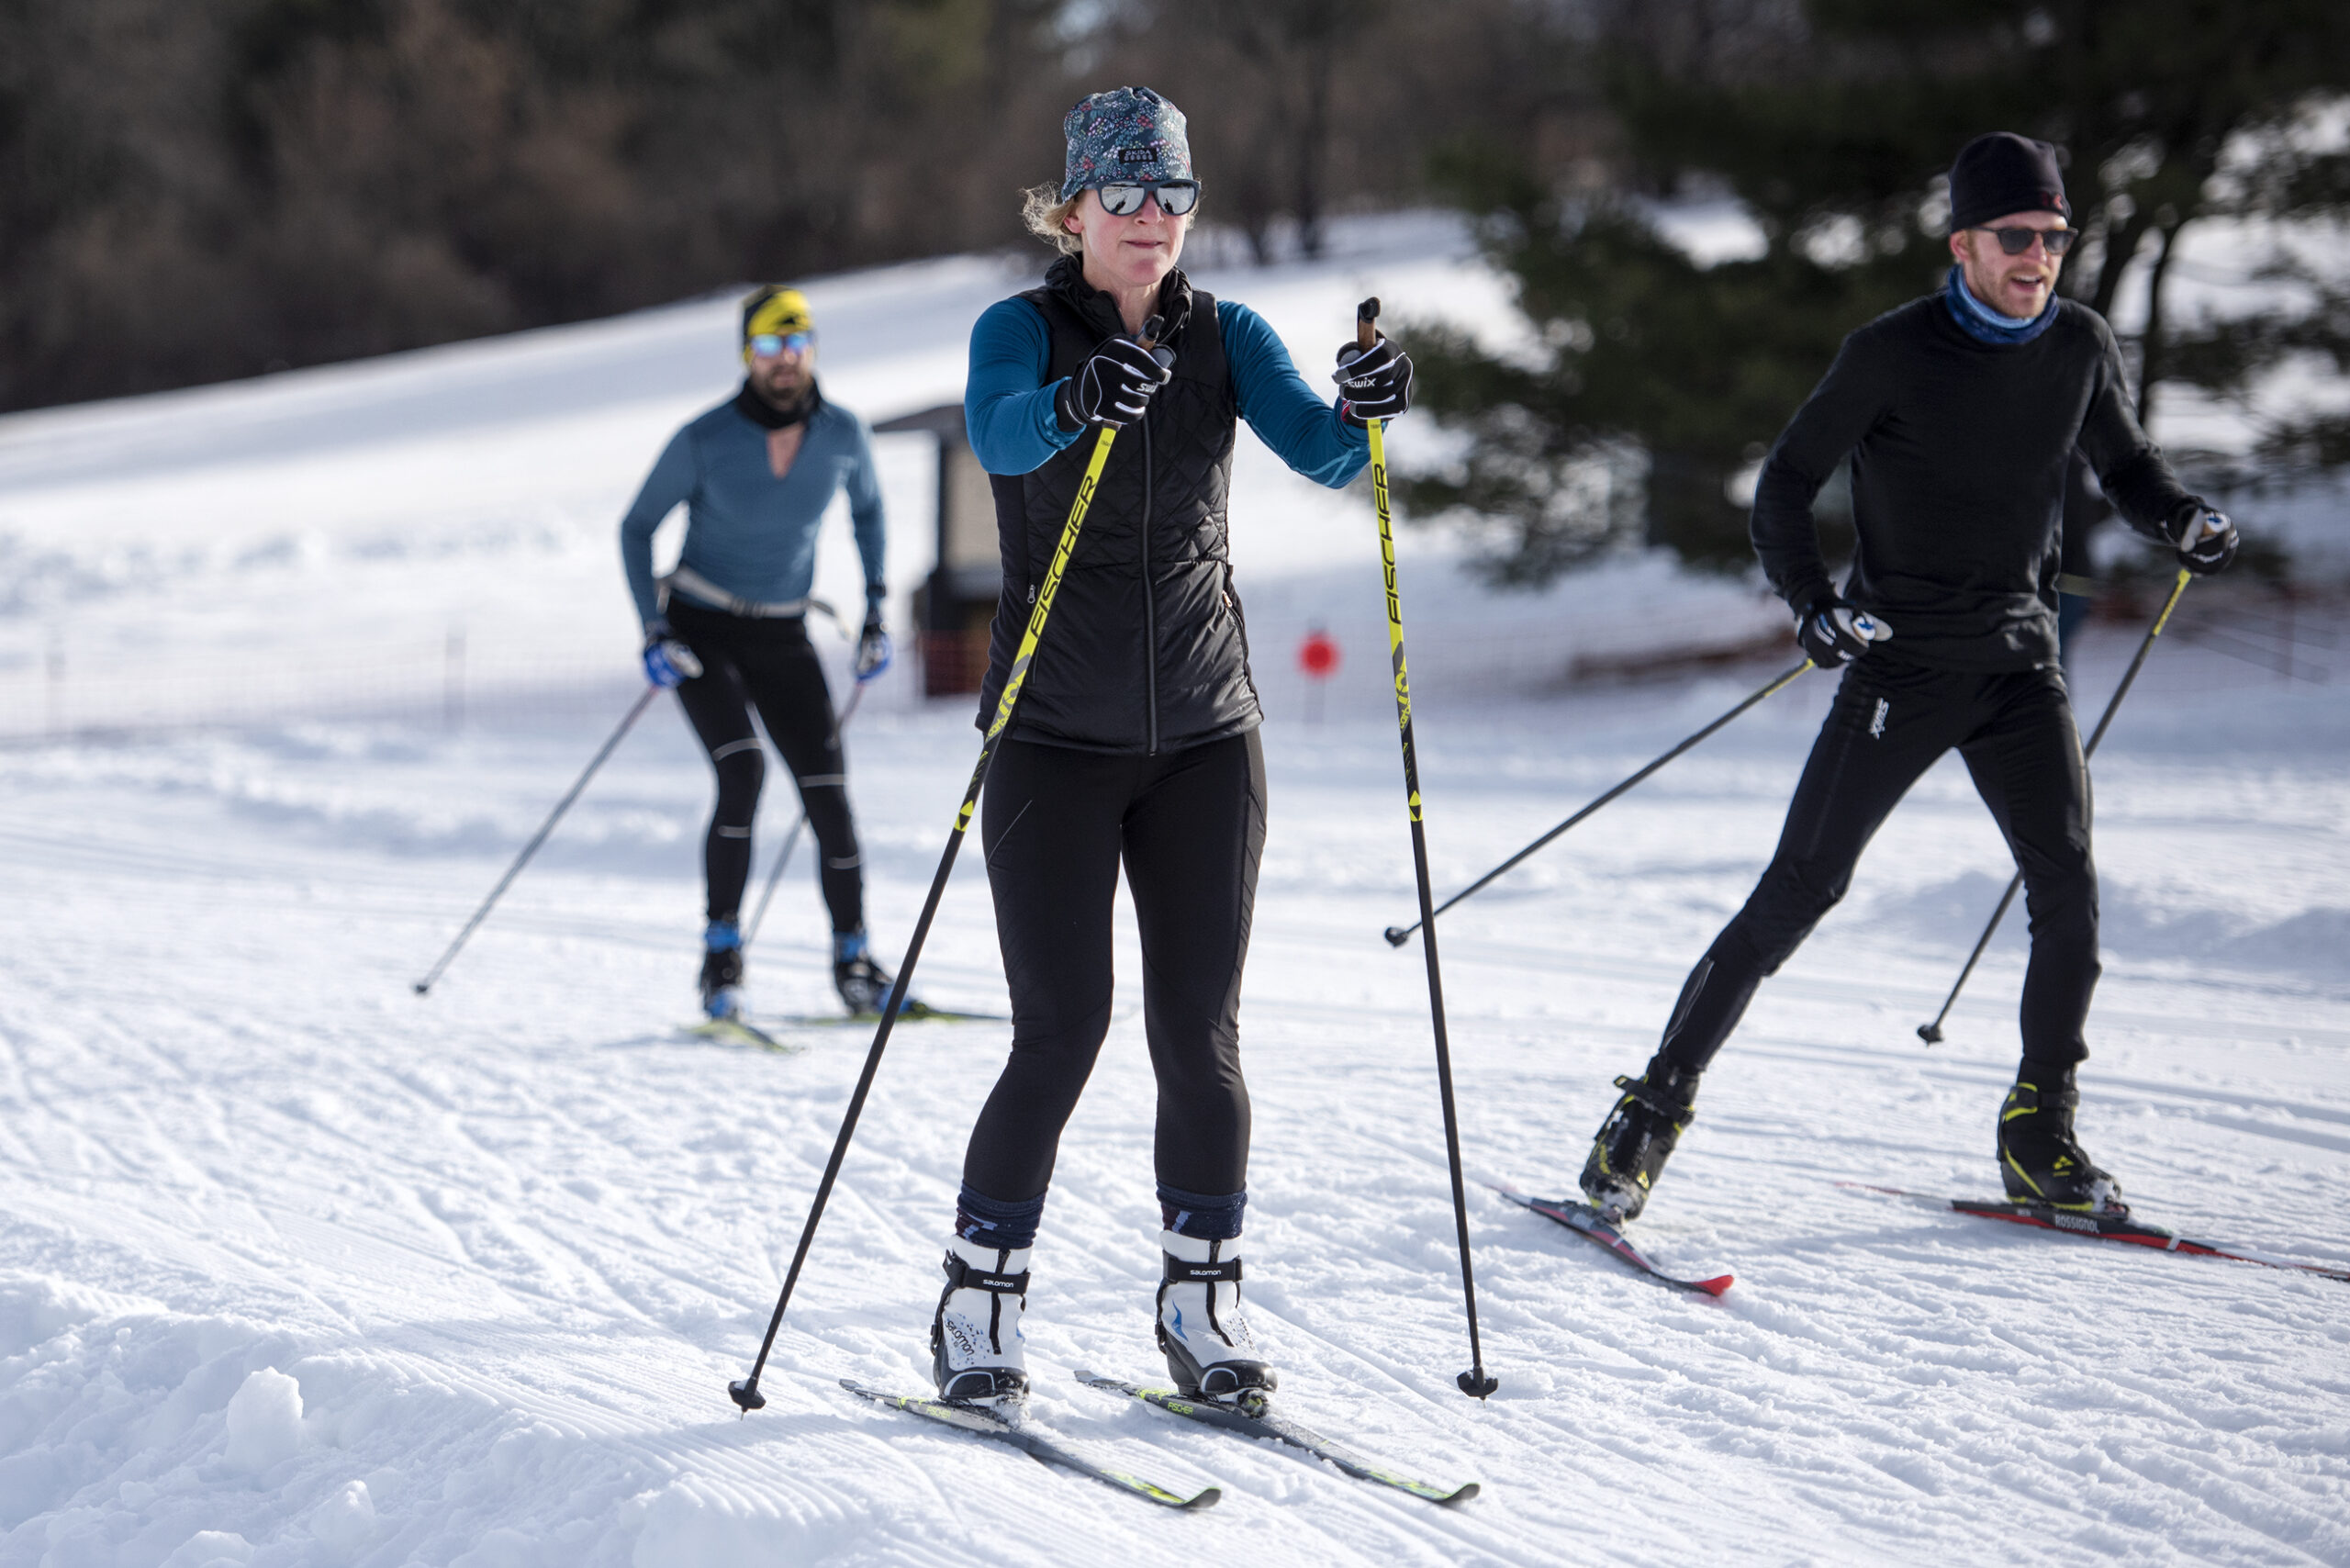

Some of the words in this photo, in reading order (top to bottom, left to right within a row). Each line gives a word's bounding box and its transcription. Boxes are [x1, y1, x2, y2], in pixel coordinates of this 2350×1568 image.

[1030, 474, 1097, 640] FISCHER
[1374, 463, 1403, 625] FISCHER
[2053, 1212, 2100, 1235] ROSSIGNOL
[1167, 1401, 1193, 1416] FISCHER
